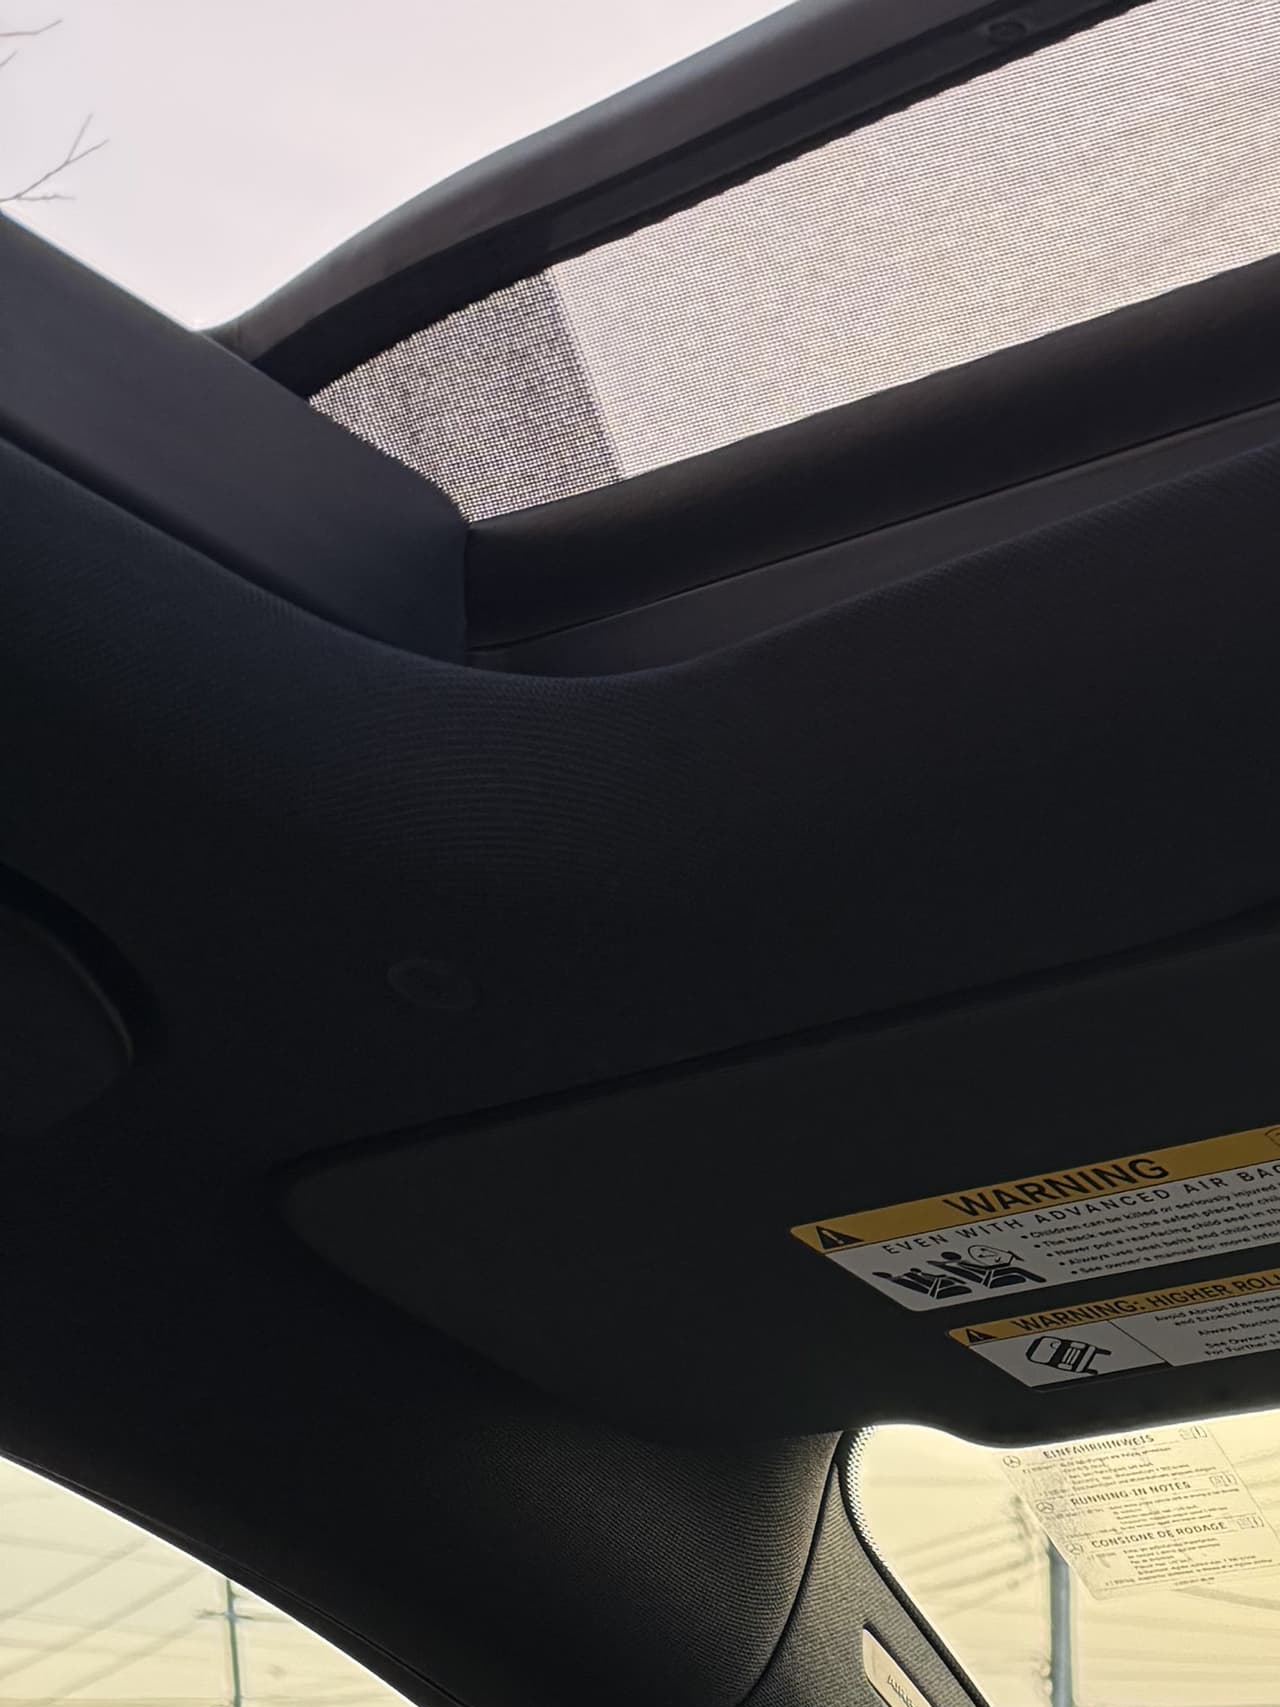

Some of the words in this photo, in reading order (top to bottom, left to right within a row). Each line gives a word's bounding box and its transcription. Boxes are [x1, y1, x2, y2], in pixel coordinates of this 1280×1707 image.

[944, 1158, 1169, 1217] WARNING
[1028, 1225, 1082, 1239] Children
[1081, 1219, 1106, 1228] can
[1104, 1216, 1123, 1224] be
[1121, 1208, 1159, 1220] killed
[1158, 1205, 1173, 1213] or
[1174, 1195, 1232, 1210] seriously
[1232, 1183, 1278, 1198] injured
[882, 1234, 948, 1255] EVEN
[955, 1219, 1024, 1239] WITH
[1035, 1189, 1170, 1224] ADVANCED
[1183, 1177, 1229, 1194] AIR
[1013, 1300, 1143, 1331] WARNING:
[1146, 1284, 1230, 1306] HIGHER
[1148, 1480, 1191, 1493] NOTES
[1156, 1529, 1174, 1538] DE
[1175, 1521, 1225, 1535] RODAGE
